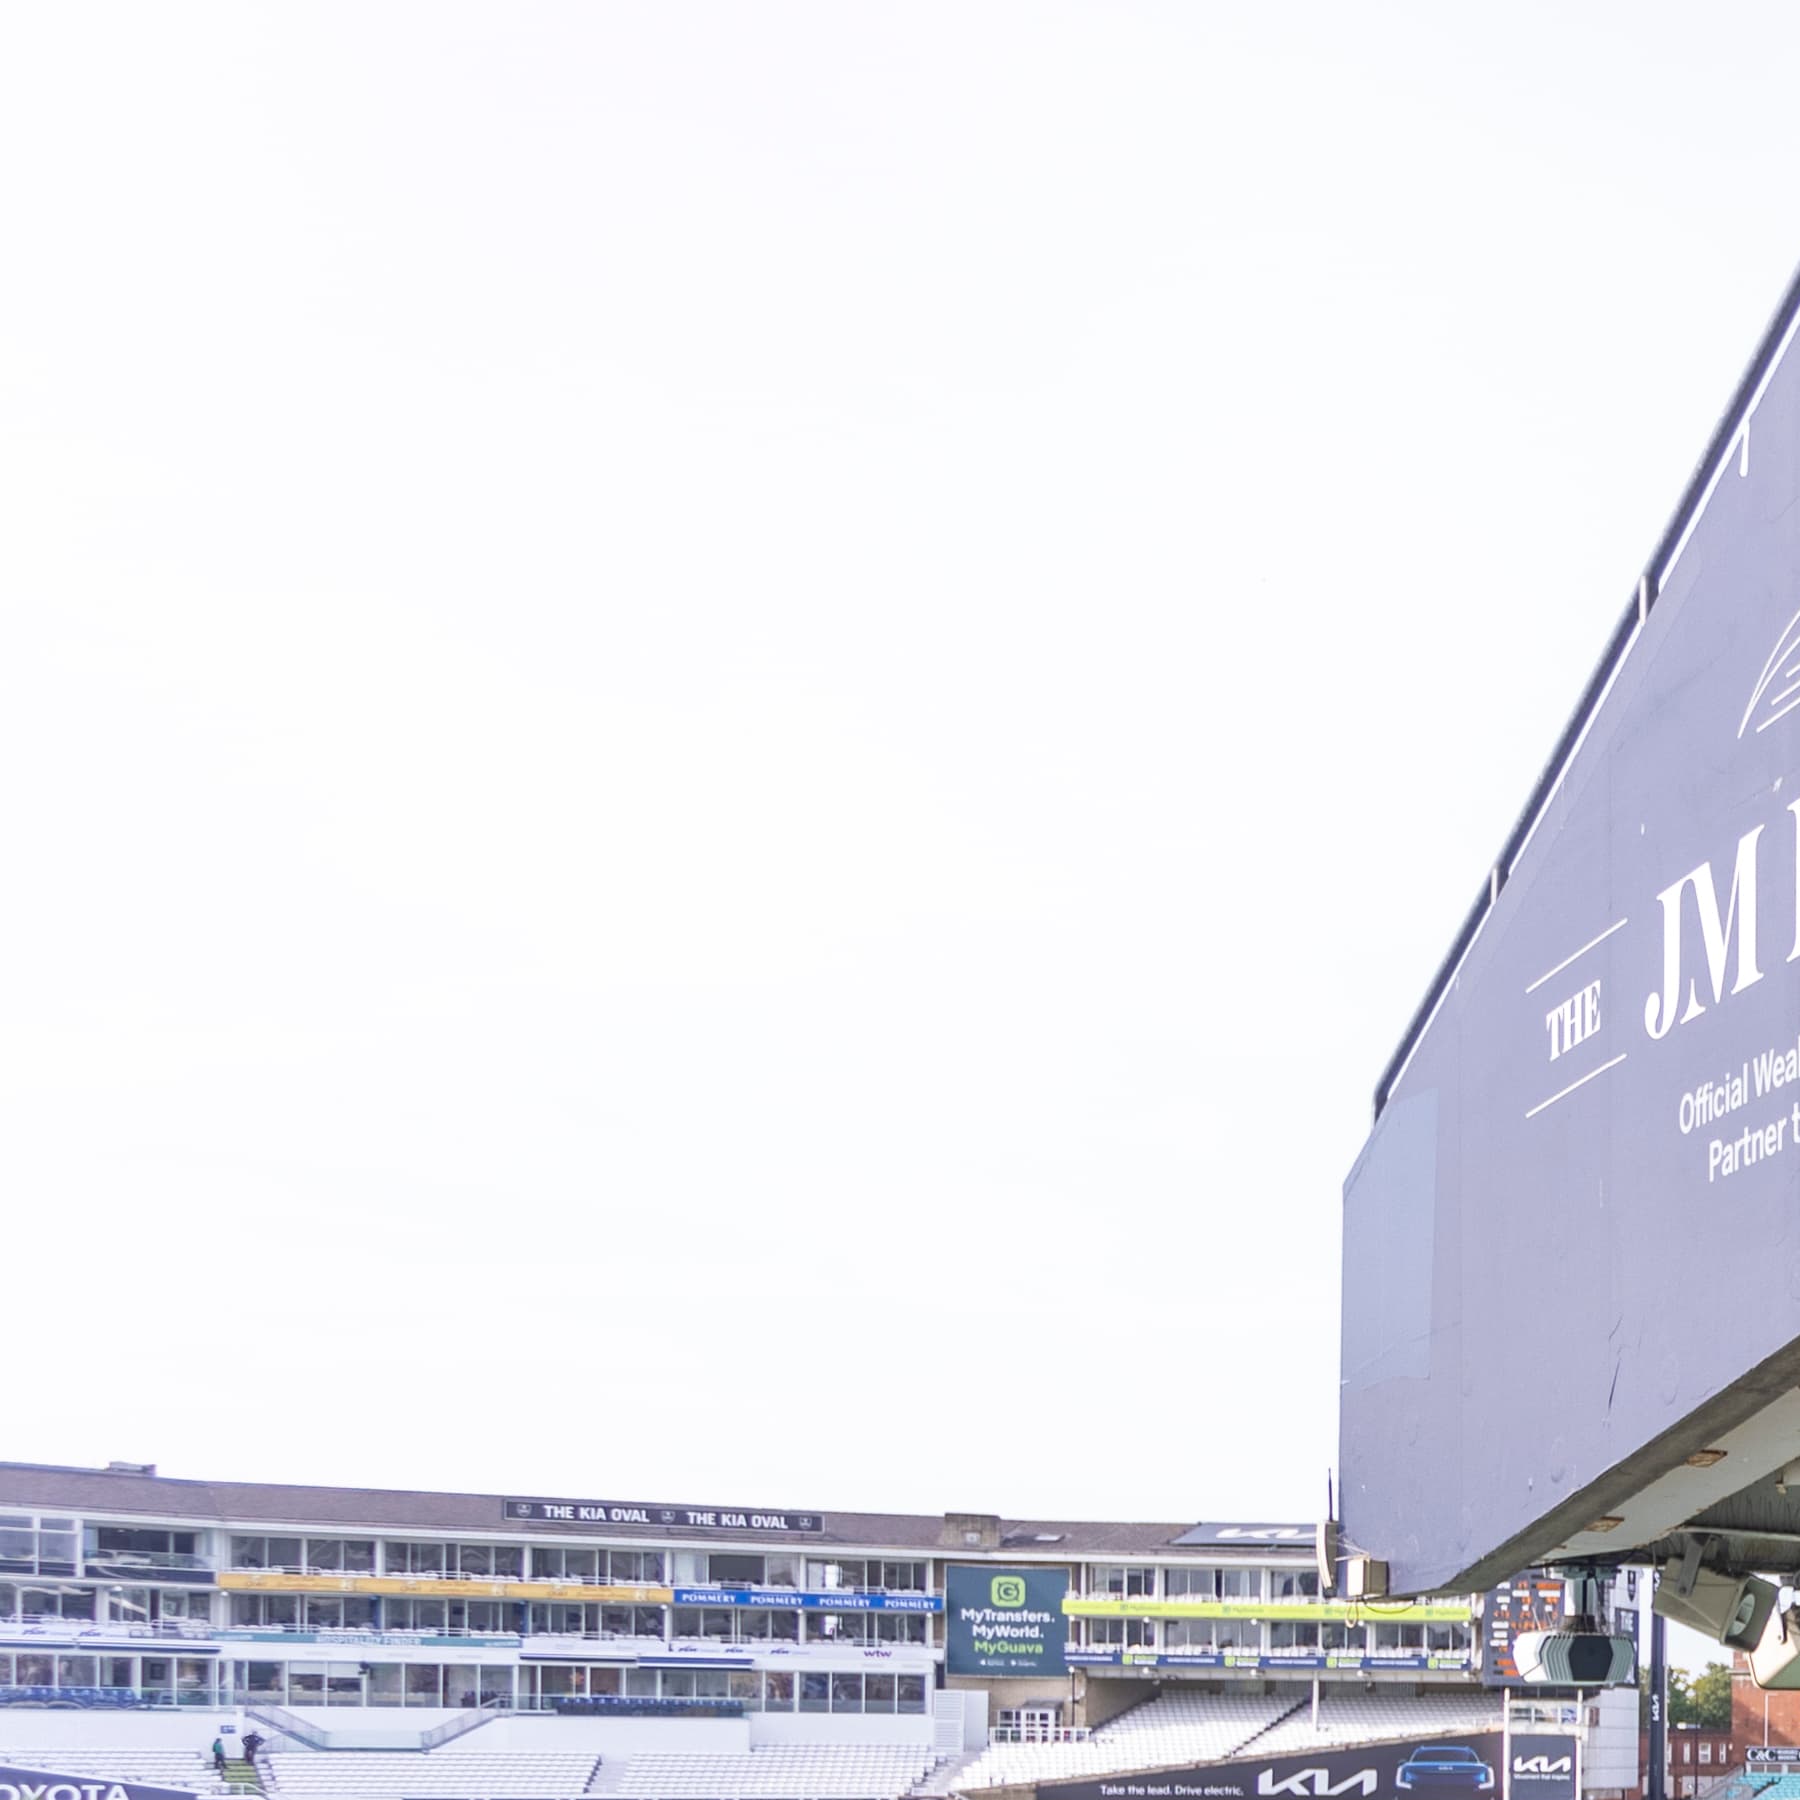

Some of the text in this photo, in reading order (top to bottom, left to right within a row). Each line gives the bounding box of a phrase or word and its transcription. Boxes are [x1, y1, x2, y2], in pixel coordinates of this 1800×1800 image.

[1545, 978, 1603, 1063] THE
[1644, 823, 1765, 1041] JM
[1678, 1072, 1749, 1135] Official
[1708, 1116, 1786, 1184] Partner
[544, 1504, 650, 1523] THE KIA OVAL
[687, 1511, 789, 1530] THE KIA OVAL
[682, 1593, 736, 1604] POMMERY
[751, 1595, 803, 1606] POMMERY
[819, 1597, 871, 1608] POMMERY
[885, 1599, 935, 1610] POMMERY
[960, 1608, 1056, 1624] MyTransfers.
[972, 1624, 1044, 1640] MyWorld.
[863, 1649, 892, 1659] wtw
[974, 1640, 1044, 1656] MyGuava
[1513, 1755, 1571, 1773] KIA
[1256, 1767, 1378, 1797] KIA
[1100, 1784, 1244, 1797] Take the lead. Drive electric.
